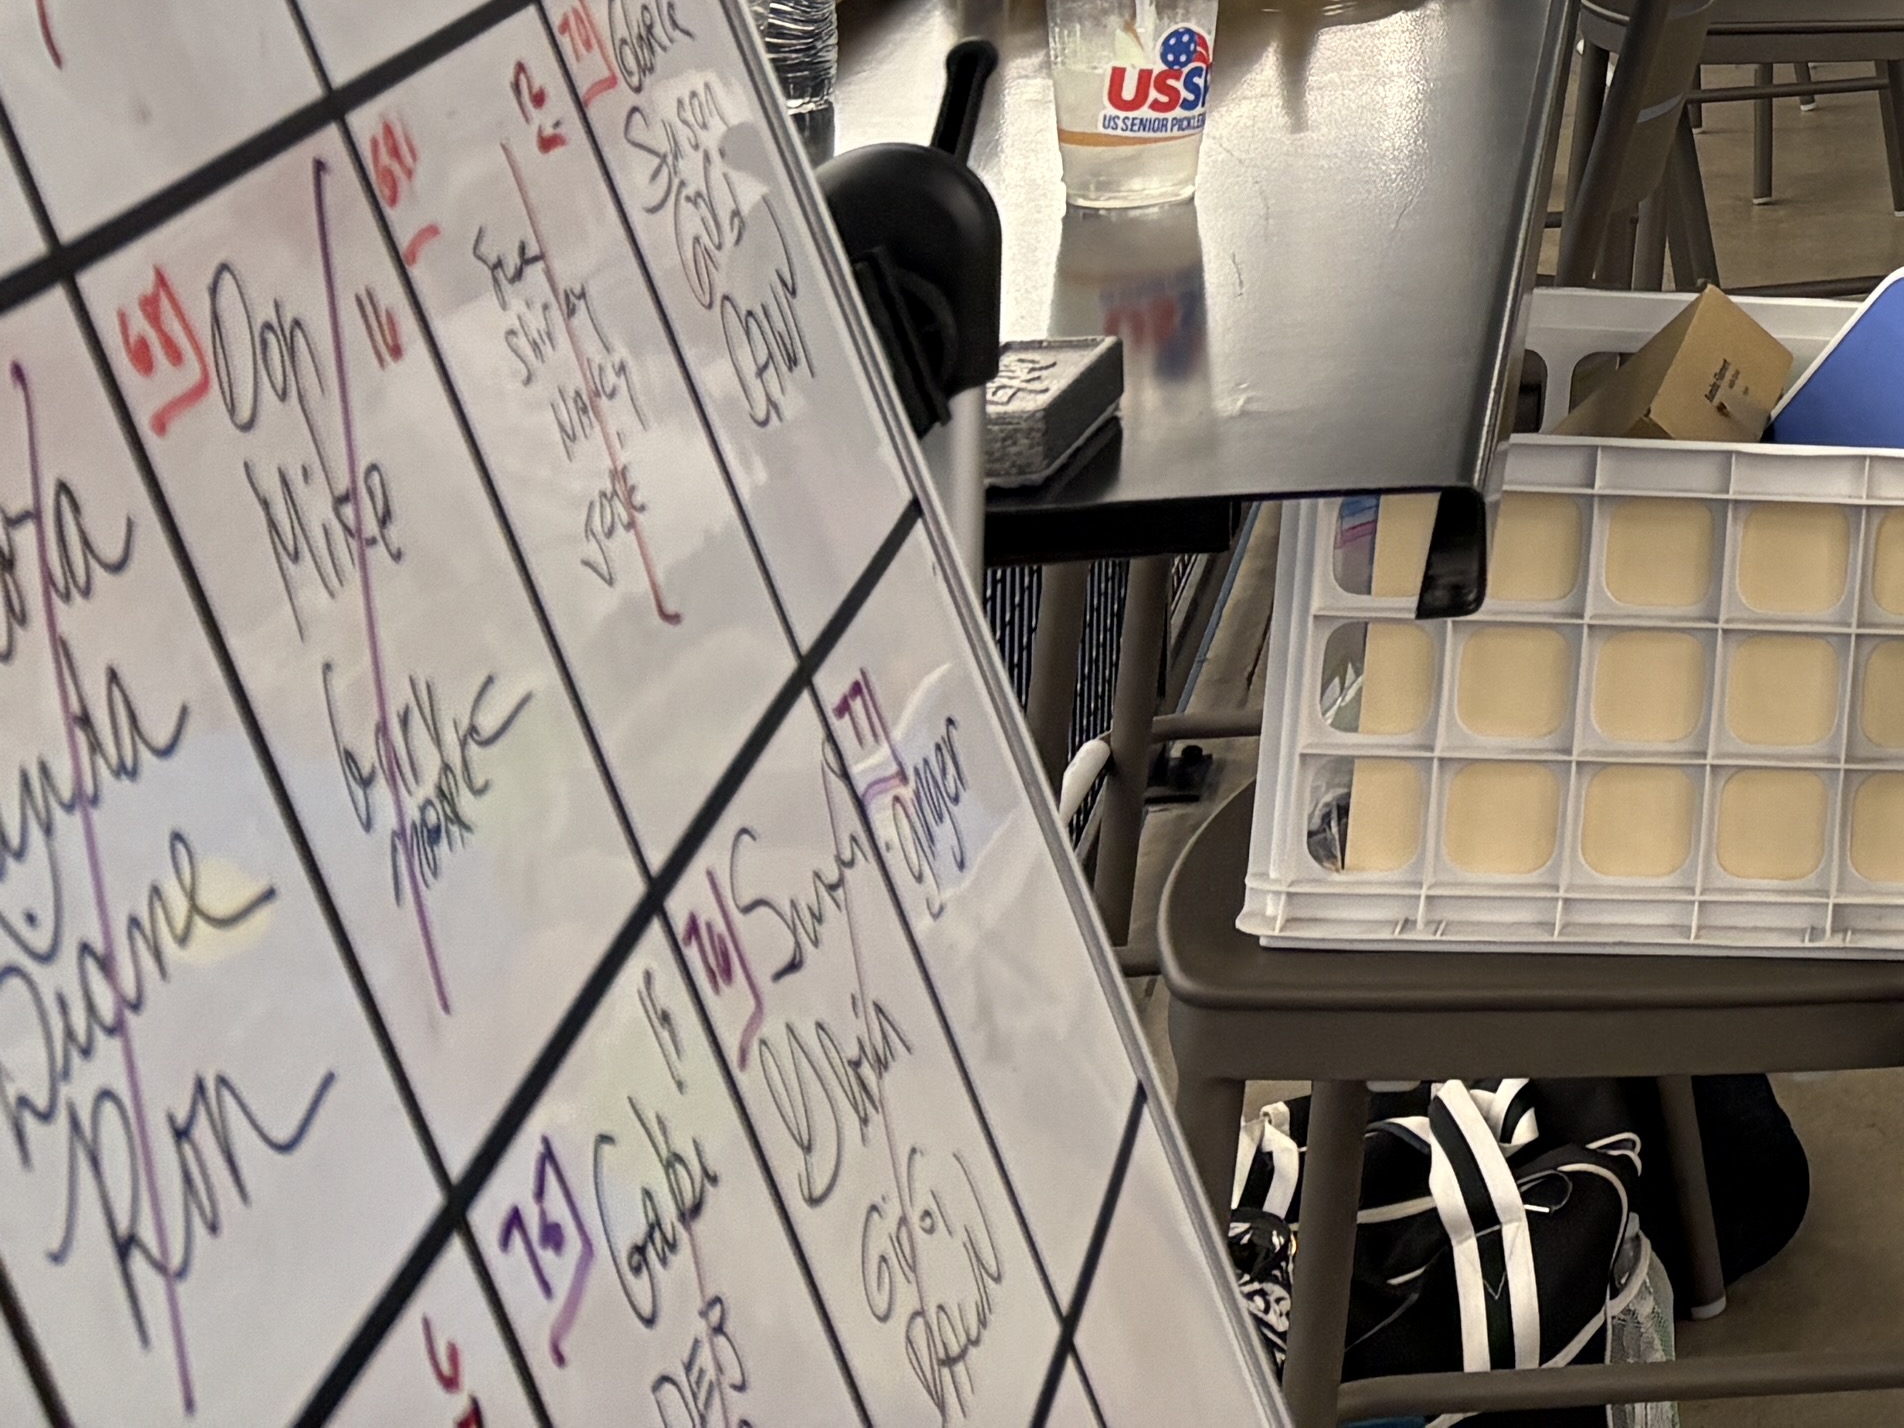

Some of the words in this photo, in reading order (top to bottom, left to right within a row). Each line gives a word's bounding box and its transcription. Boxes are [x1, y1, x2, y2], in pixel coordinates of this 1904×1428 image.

[1101, 114, 1121, 130] US
[1120, 115, 1169, 133] SENIOR
[209, 262, 324, 431] Don
